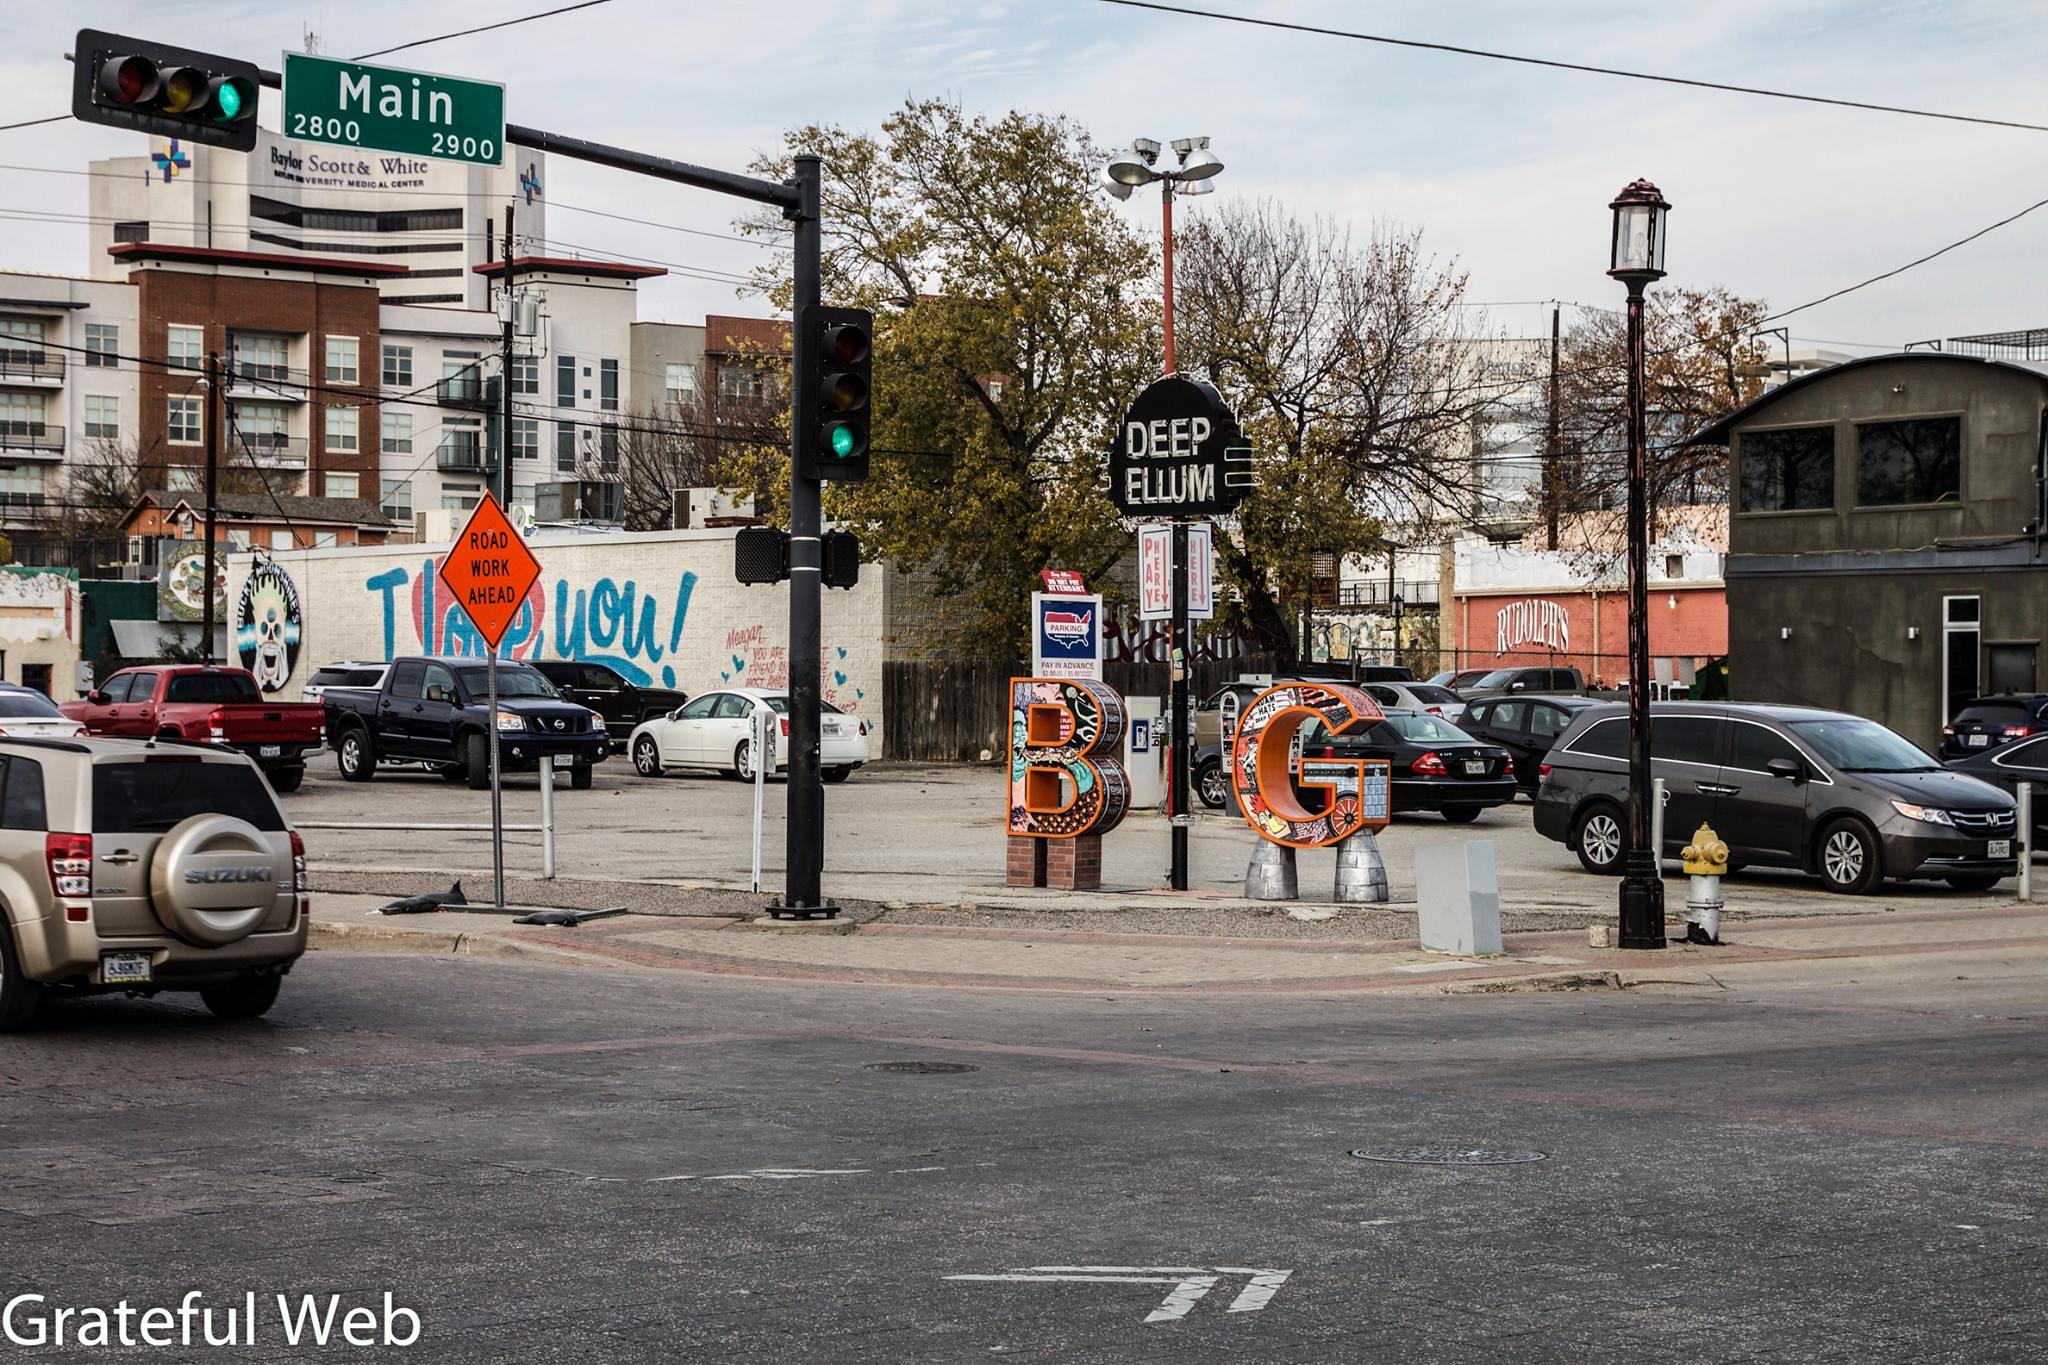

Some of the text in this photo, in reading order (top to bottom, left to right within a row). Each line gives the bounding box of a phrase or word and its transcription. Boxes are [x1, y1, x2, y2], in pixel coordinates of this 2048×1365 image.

[339, 71, 453, 126] Main
[293, 114, 495, 160] 2800 2900
[271, 146, 303, 171] Baylor
[308, 155, 354, 175] Scott
[380, 157, 428, 175] White
[347, 179, 388, 189] MEDICAL
[391, 179, 425, 188] CENTER
[1126, 417, 1211, 460] DEEP
[1125, 463, 1215, 505] ELLUM
[470, 531, 509, 550] ROAD
[470, 559, 510, 578] WORK
[468, 586, 516, 606] AHEAD
[1050, 624, 1083, 633] PARKING
[1496, 599, 1568, 659] RUDOLPH'S
[1041, 661, 1095, 670] PAY IN ADVANCE
[1258, 703, 1276, 716] HATS
[184, 866, 273, 885] SUZUKI
